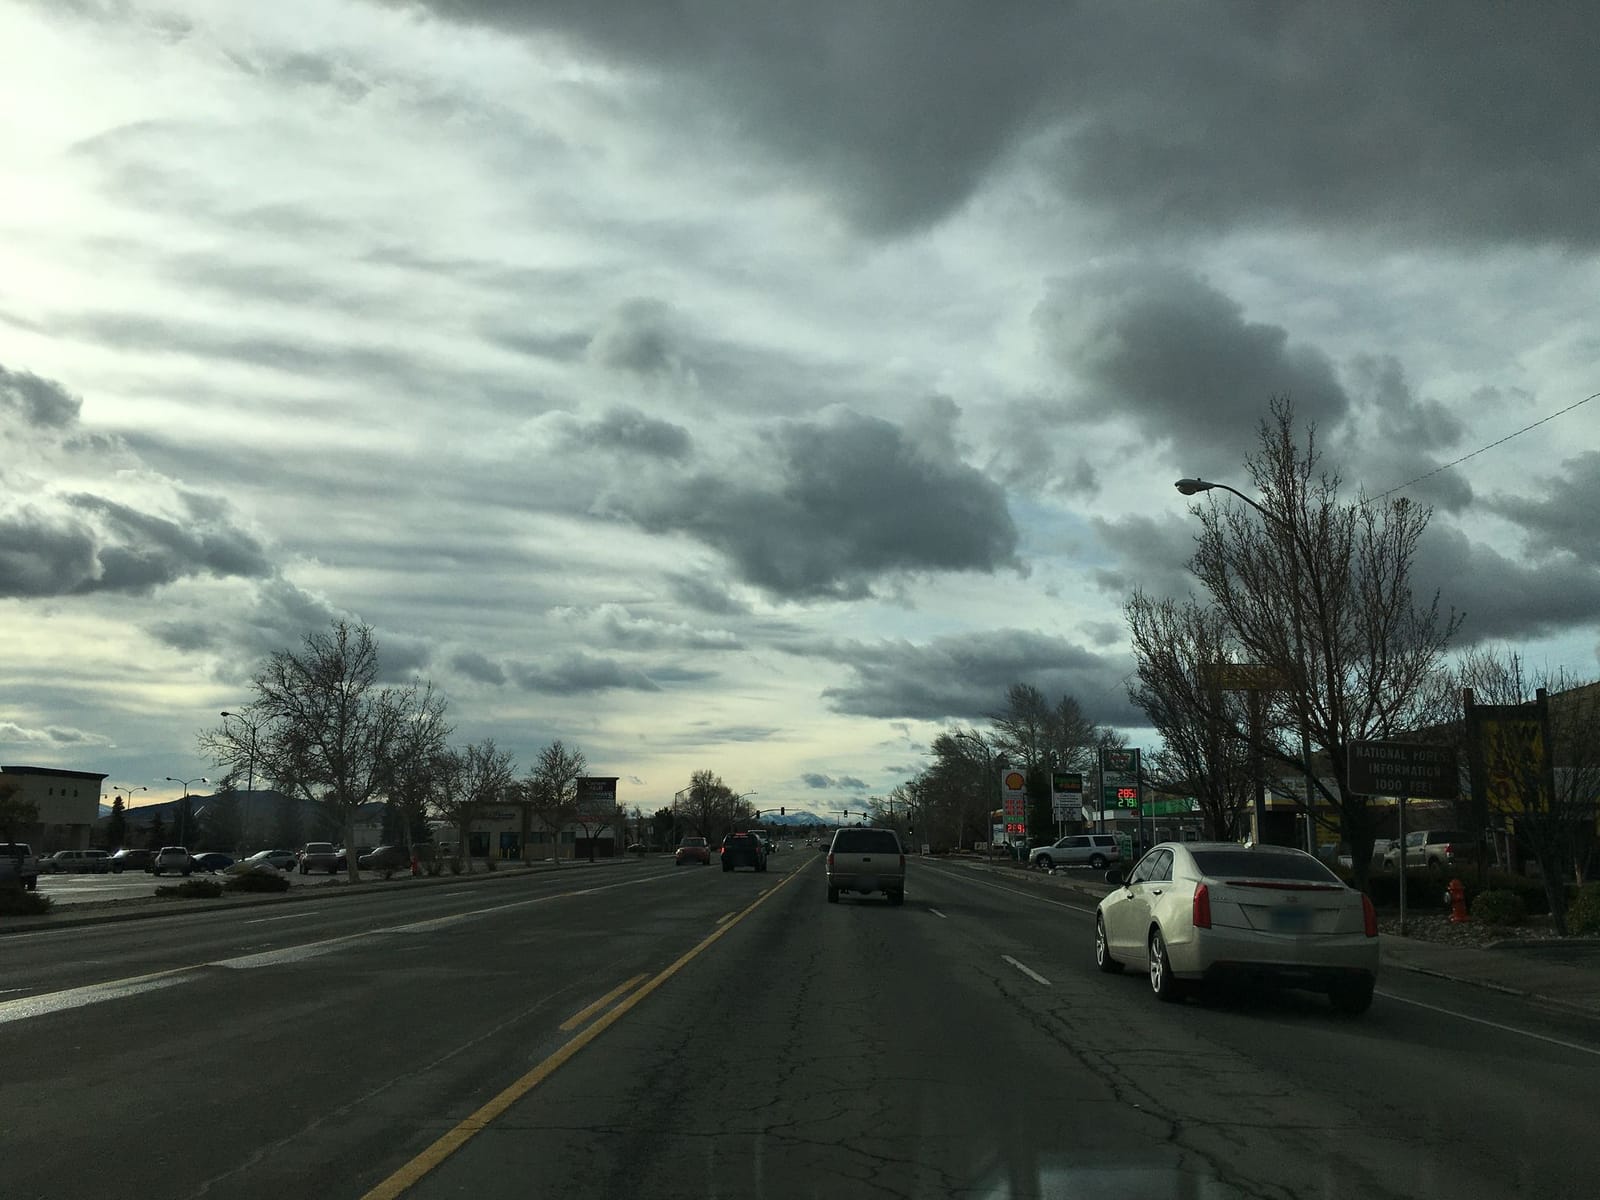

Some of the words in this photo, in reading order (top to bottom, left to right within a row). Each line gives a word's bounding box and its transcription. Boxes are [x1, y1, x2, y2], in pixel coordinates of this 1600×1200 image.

[1355, 746, 1408, 761] NATIONAL
[1368, 762, 1441, 777] INFORMATION
[1375, 779, 1402, 791] 1000
[1409, 780, 1433, 793] FEET
